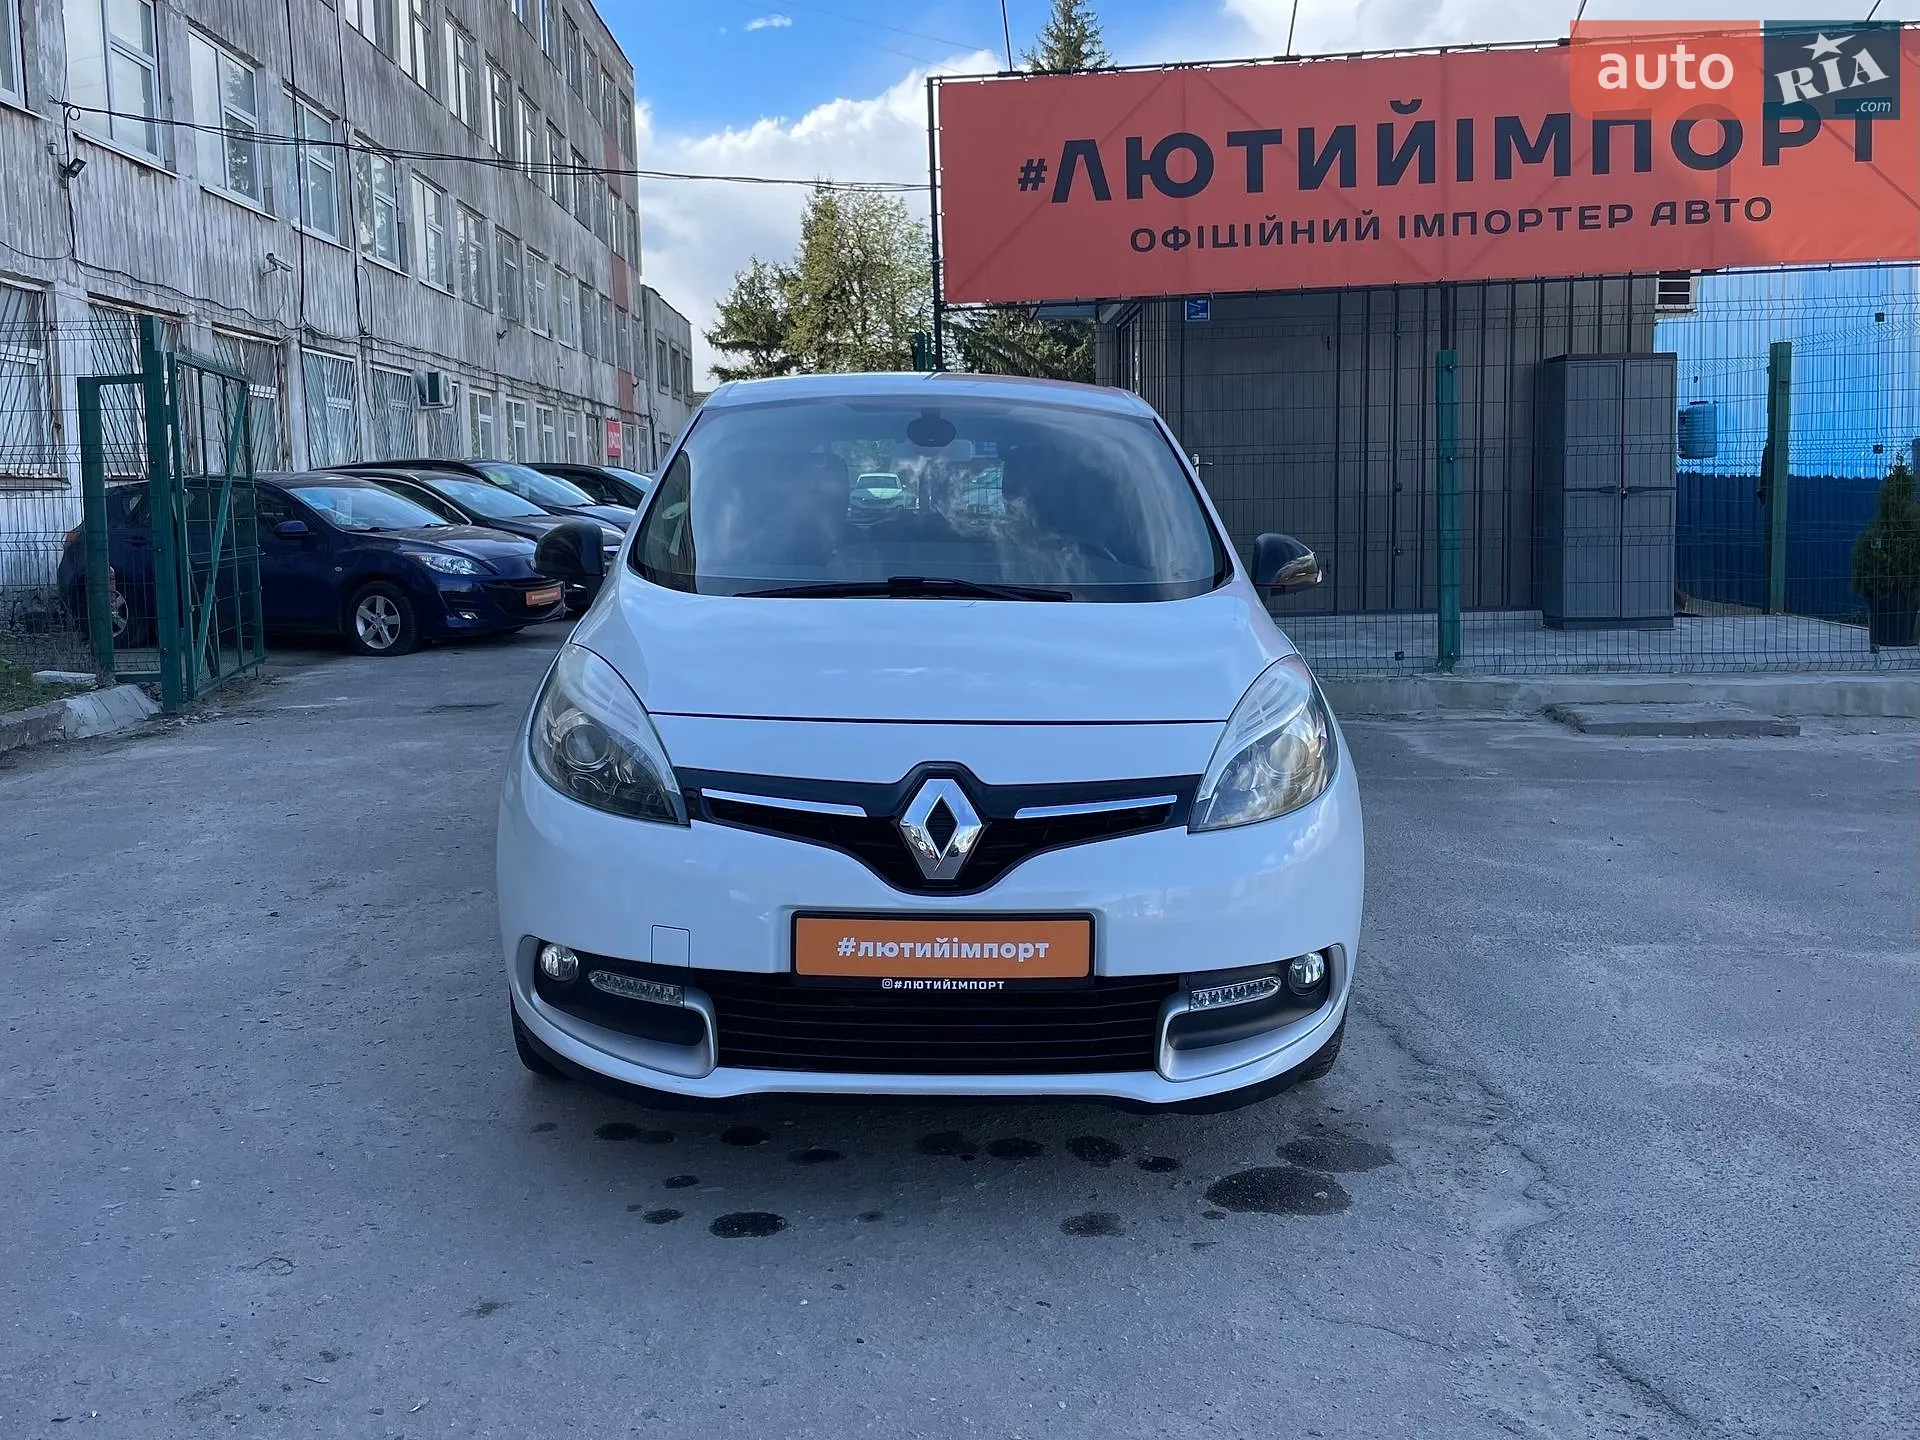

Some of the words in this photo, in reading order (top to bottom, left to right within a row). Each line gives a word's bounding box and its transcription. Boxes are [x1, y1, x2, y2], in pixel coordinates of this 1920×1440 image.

[1018, 97, 1892, 204] #ЛЮТИЙІМПОРТ
[1130, 209, 1381, 253] ОФІЦІЙНИЙ
[1398, 203, 1634, 239] ІМПОРТЕР
[1650, 197, 1772, 227] АВТО
[837, 937, 1050, 962] #лютийімпорт
